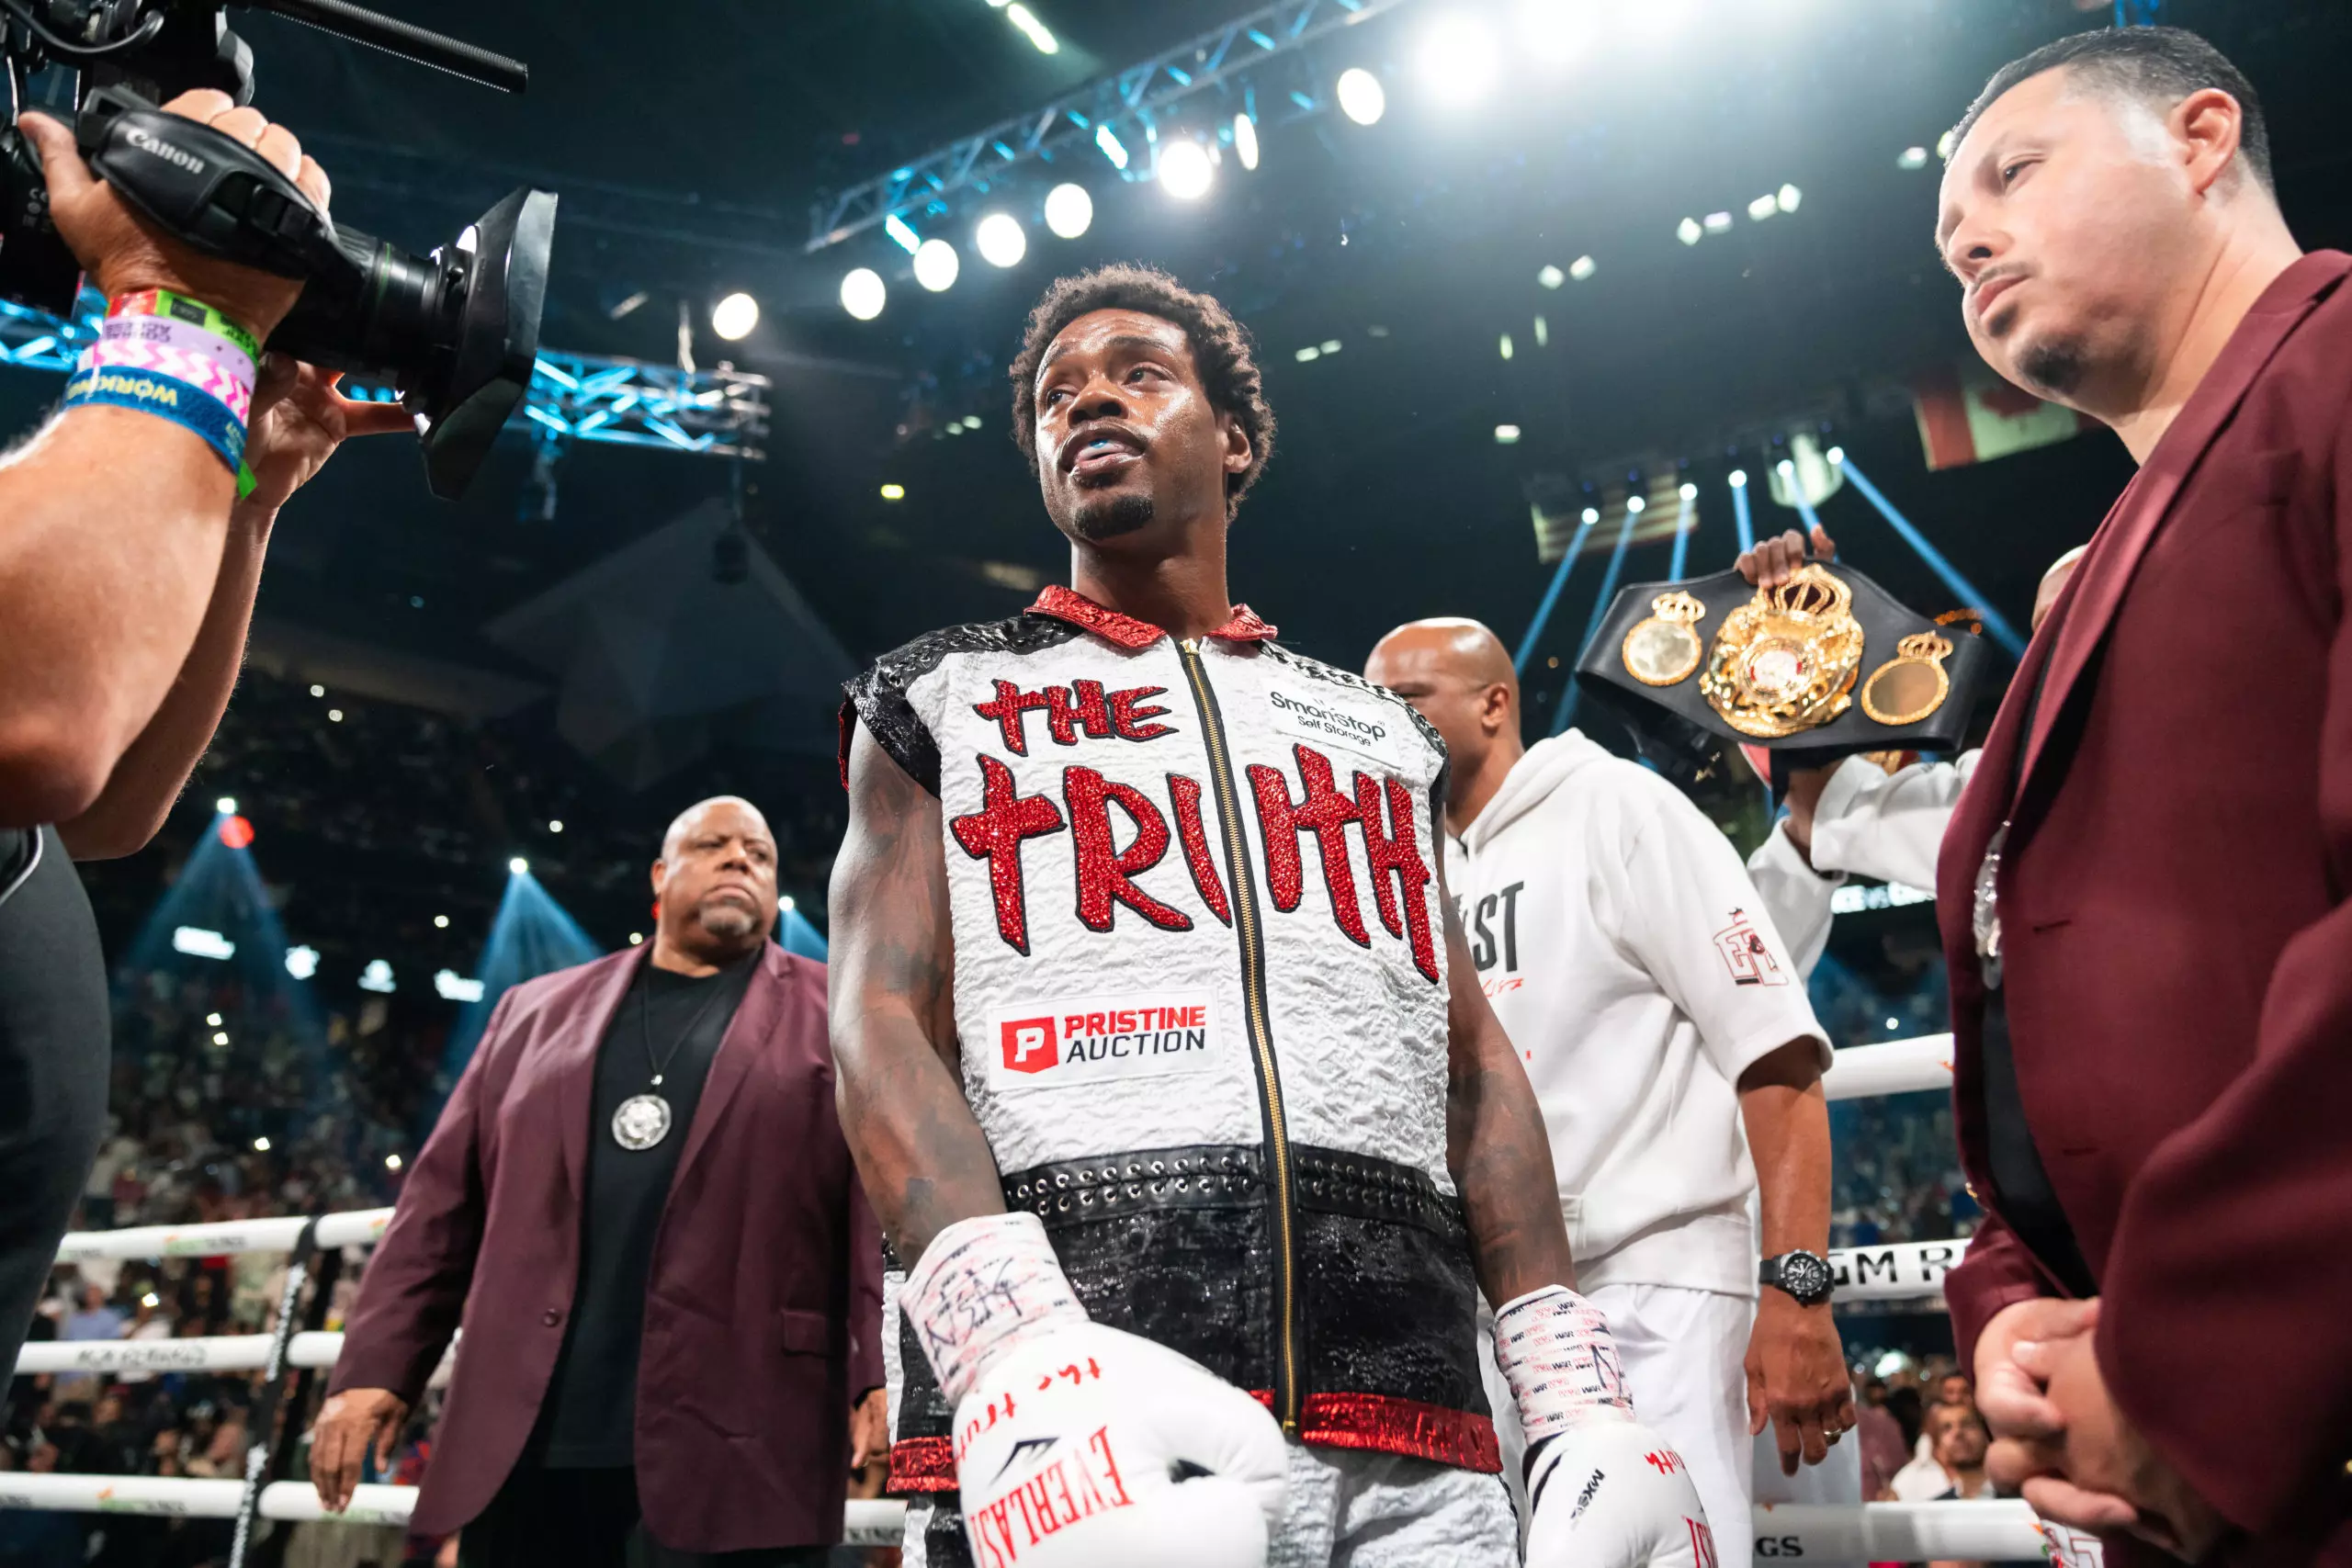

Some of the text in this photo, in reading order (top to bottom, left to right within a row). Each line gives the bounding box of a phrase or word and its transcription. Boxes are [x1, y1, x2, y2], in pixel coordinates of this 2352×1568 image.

[126, 128, 205, 175] Canon
[972, 679, 1179, 757] THE
[1297, 716, 1371, 747] Self Storage
[949, 742, 1440, 986] TRUTH
[1461, 880, 1523, 973] ST
[1064, 1005, 1206, 1039] PRISTINE
[1014, 1026, 1046, 1063] P
[1066, 1028, 1205, 1064] AUCTION
[1038, 1357, 1102, 1391] the
[1532, 1382, 1548, 1394] WAR
[1546, 1411, 1565, 1423] WAR
